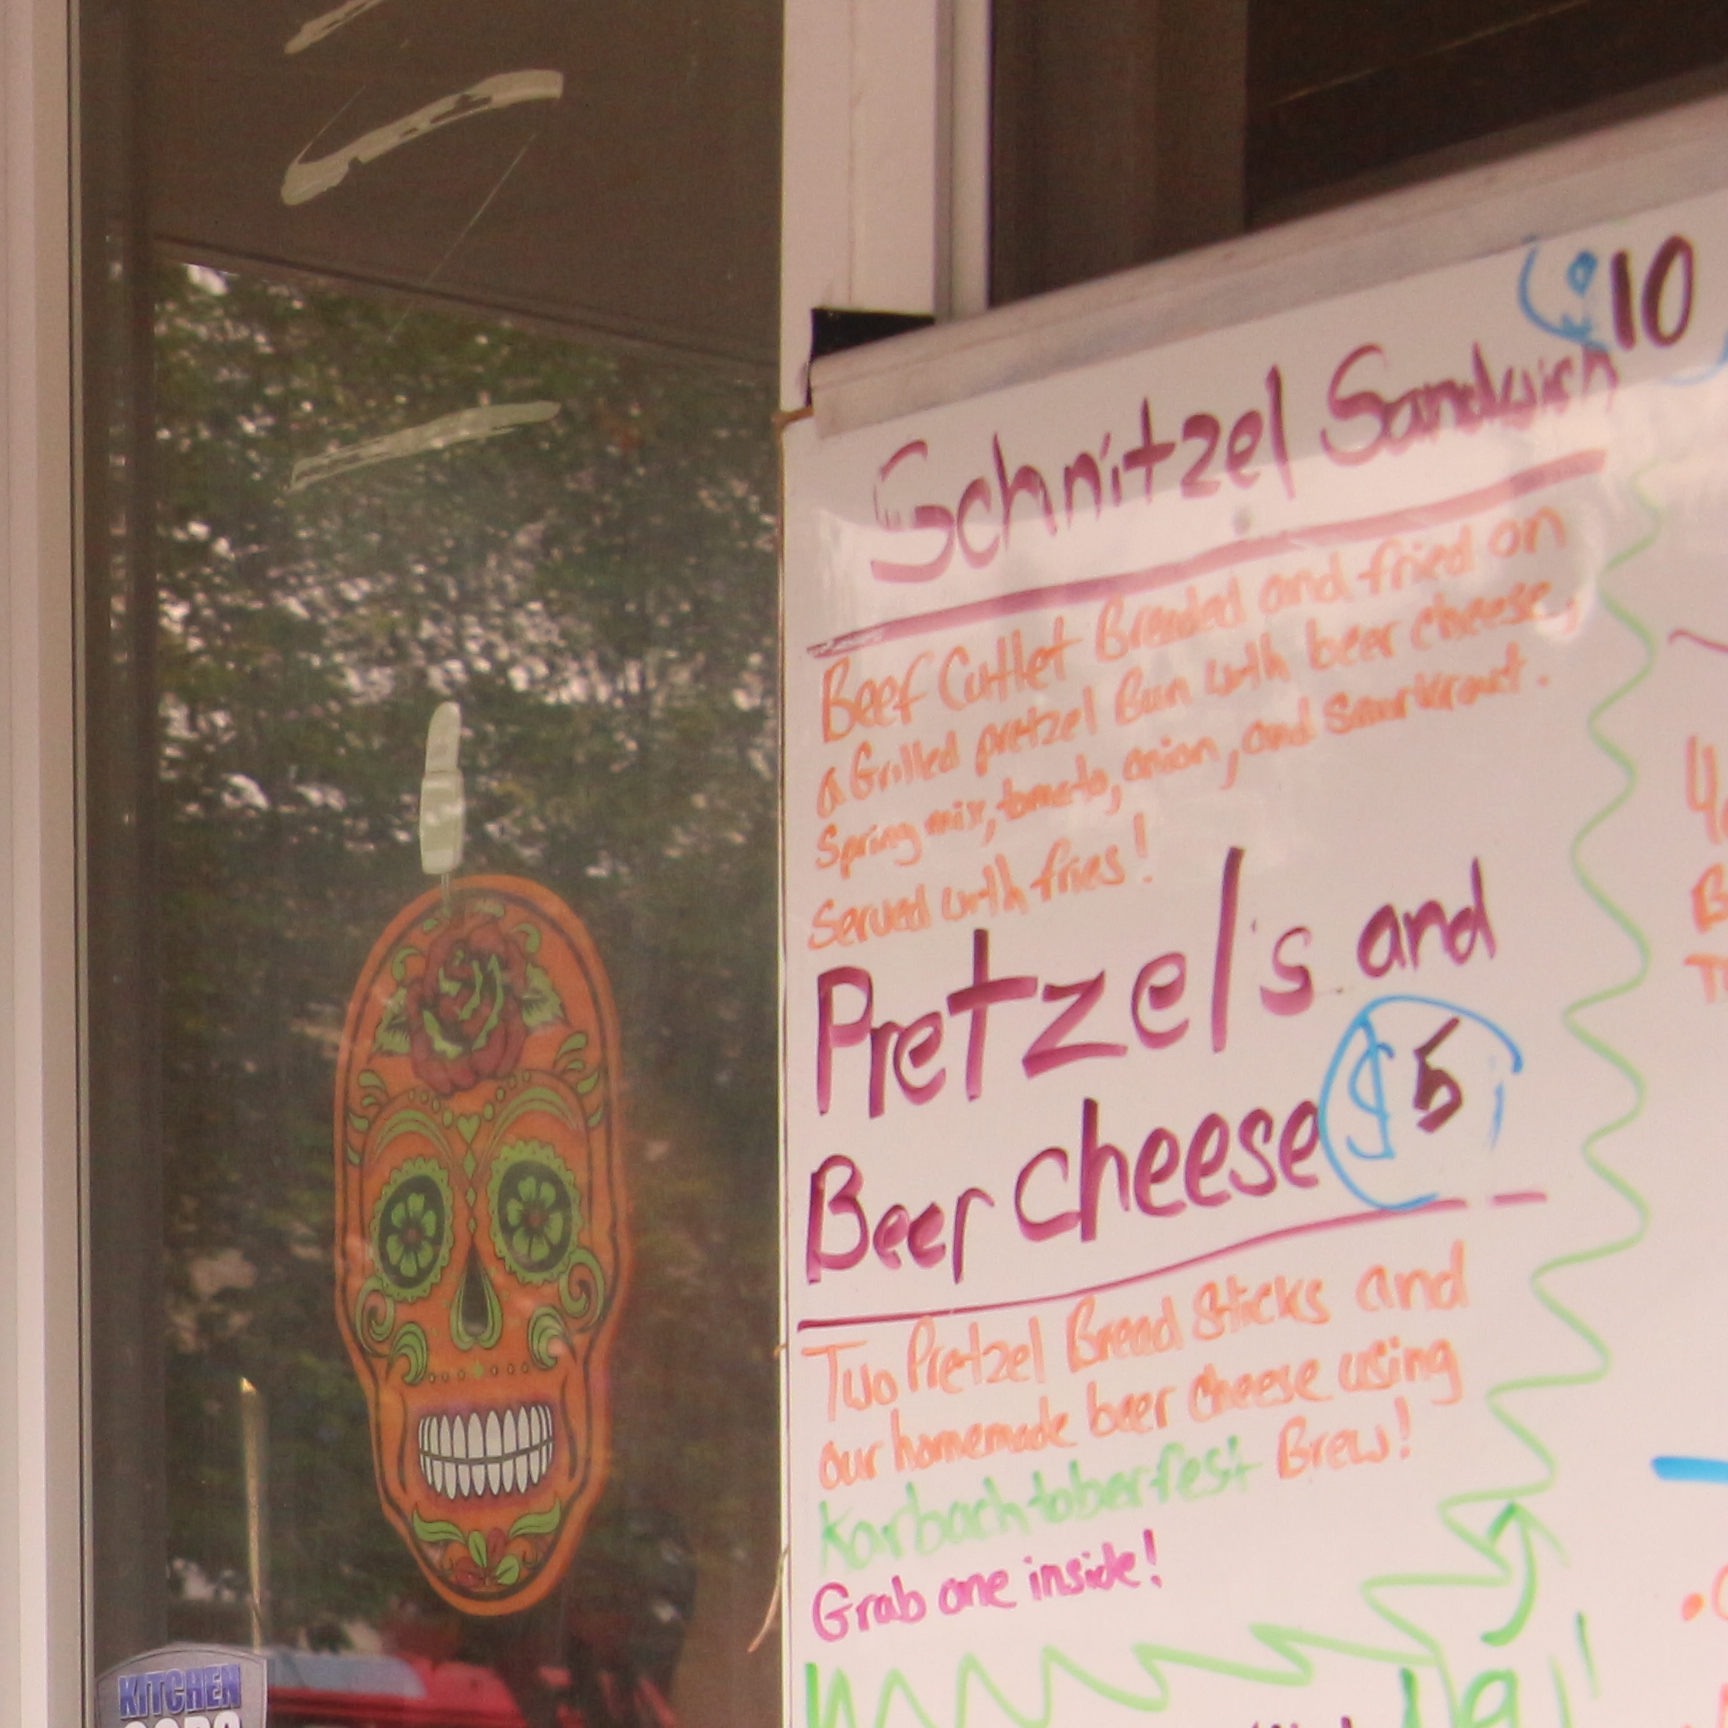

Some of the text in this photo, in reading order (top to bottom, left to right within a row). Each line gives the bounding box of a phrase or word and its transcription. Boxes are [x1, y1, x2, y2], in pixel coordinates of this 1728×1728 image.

[870, 341, 1619, 583] Schnitzel Sandwich
[822, 651, 934, 743] Beef
[1095, 577, 1247, 662] Breaded
[1258, 551, 1350, 614] and
[1358, 526, 1476, 594] fried
[1488, 508, 1568, 560] on
[849, 730, 960, 801] Grilled
[1205, 633, 1290, 697] with
[1306, 617, 1401, 672] beer
[816, 820, 924, 877] Spring
[1243, 696, 1317, 755] and
[808, 818, 1153, 950] Served with fries!
[1357, 856, 1497, 980] and
[806, 1154, 996, 1286] Beer
[802, 1239, 1473, 1421] Two Pretzel Bread Sticks and
[819, 1336, 1464, 1491] our homemade beer cheese using
[1276, 1397, 1413, 1480] Brew!
[811, 1529, 1163, 1644] Grab one inside!
[117, 1662, 243, 1722] KITCHEN
